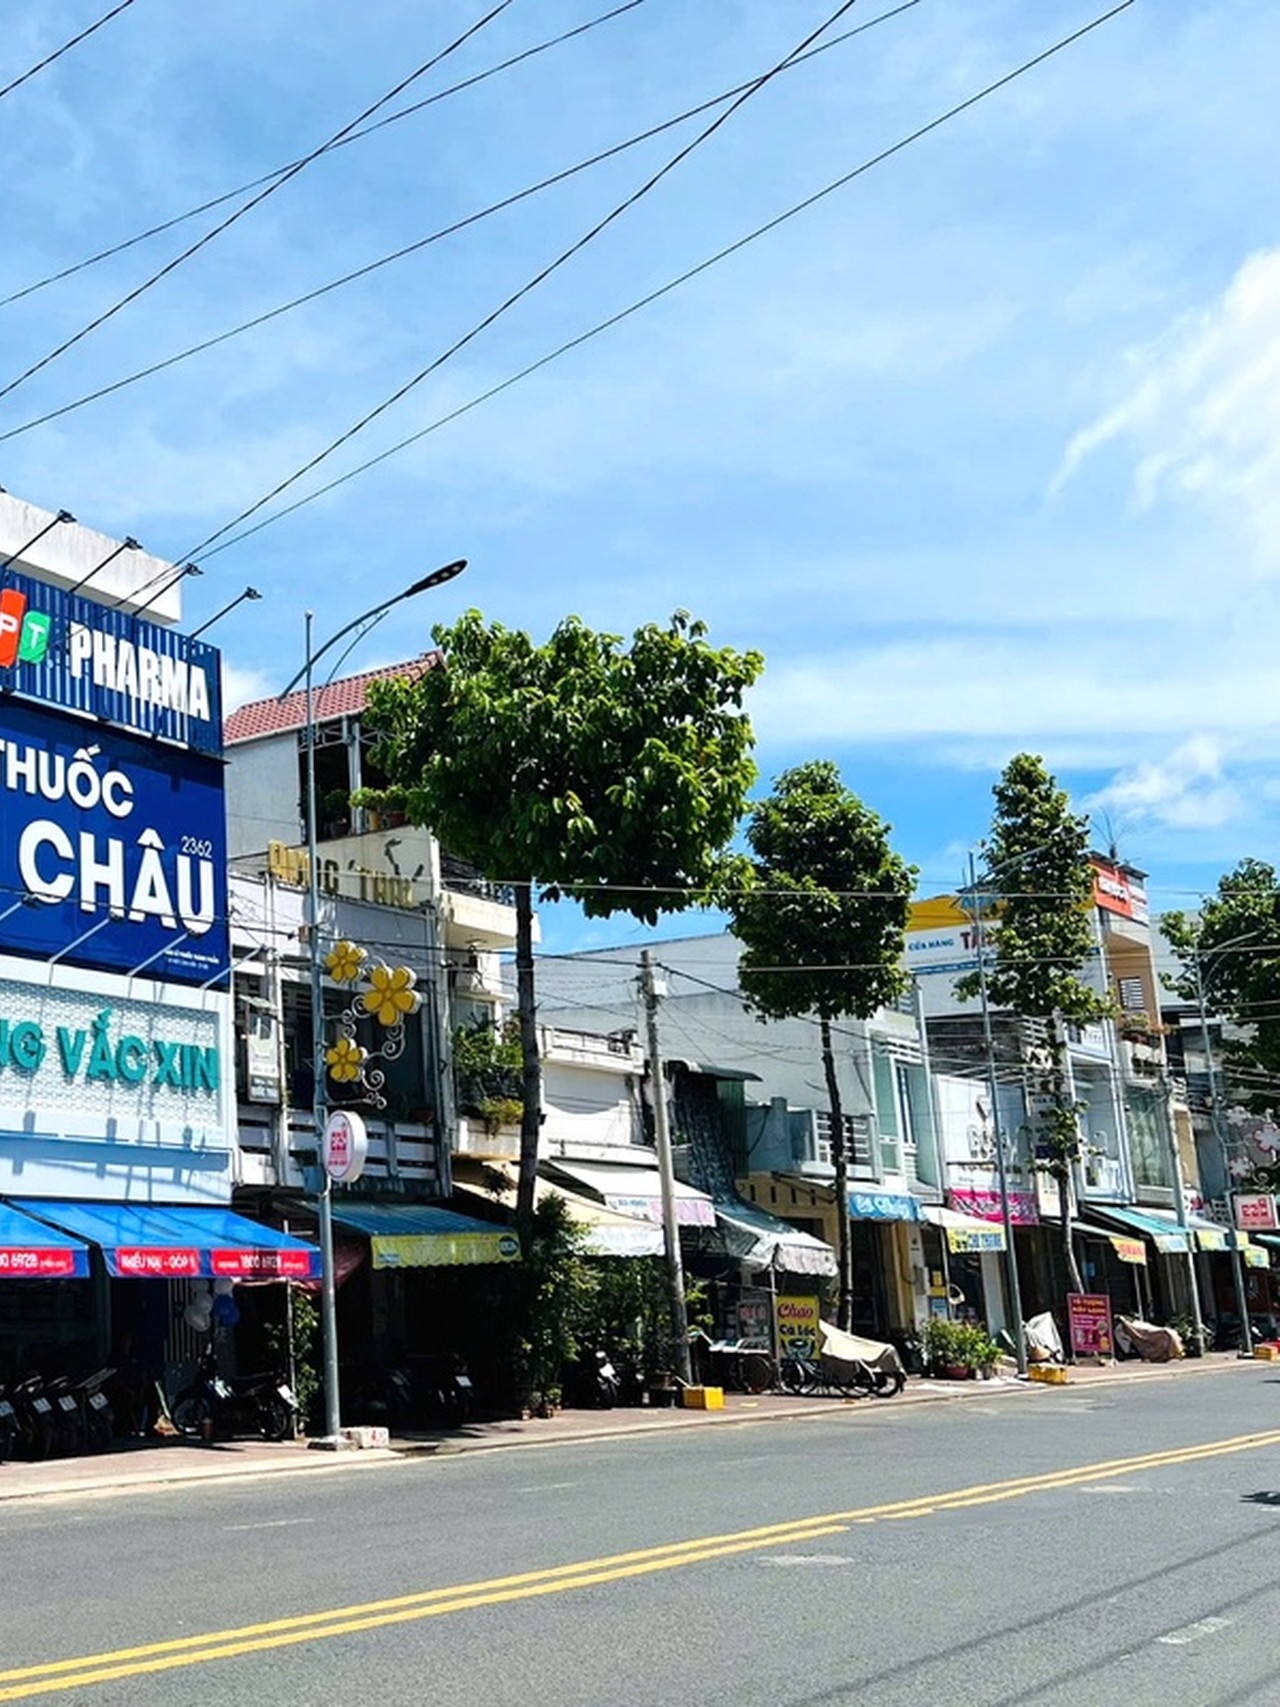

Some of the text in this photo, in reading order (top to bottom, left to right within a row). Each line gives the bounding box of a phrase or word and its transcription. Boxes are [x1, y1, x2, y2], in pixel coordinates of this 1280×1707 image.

[70, 622, 211, 723] PHARMA
[19, 827, 216, 937] CHÂU
[180, 834, 214, 859] 2362
